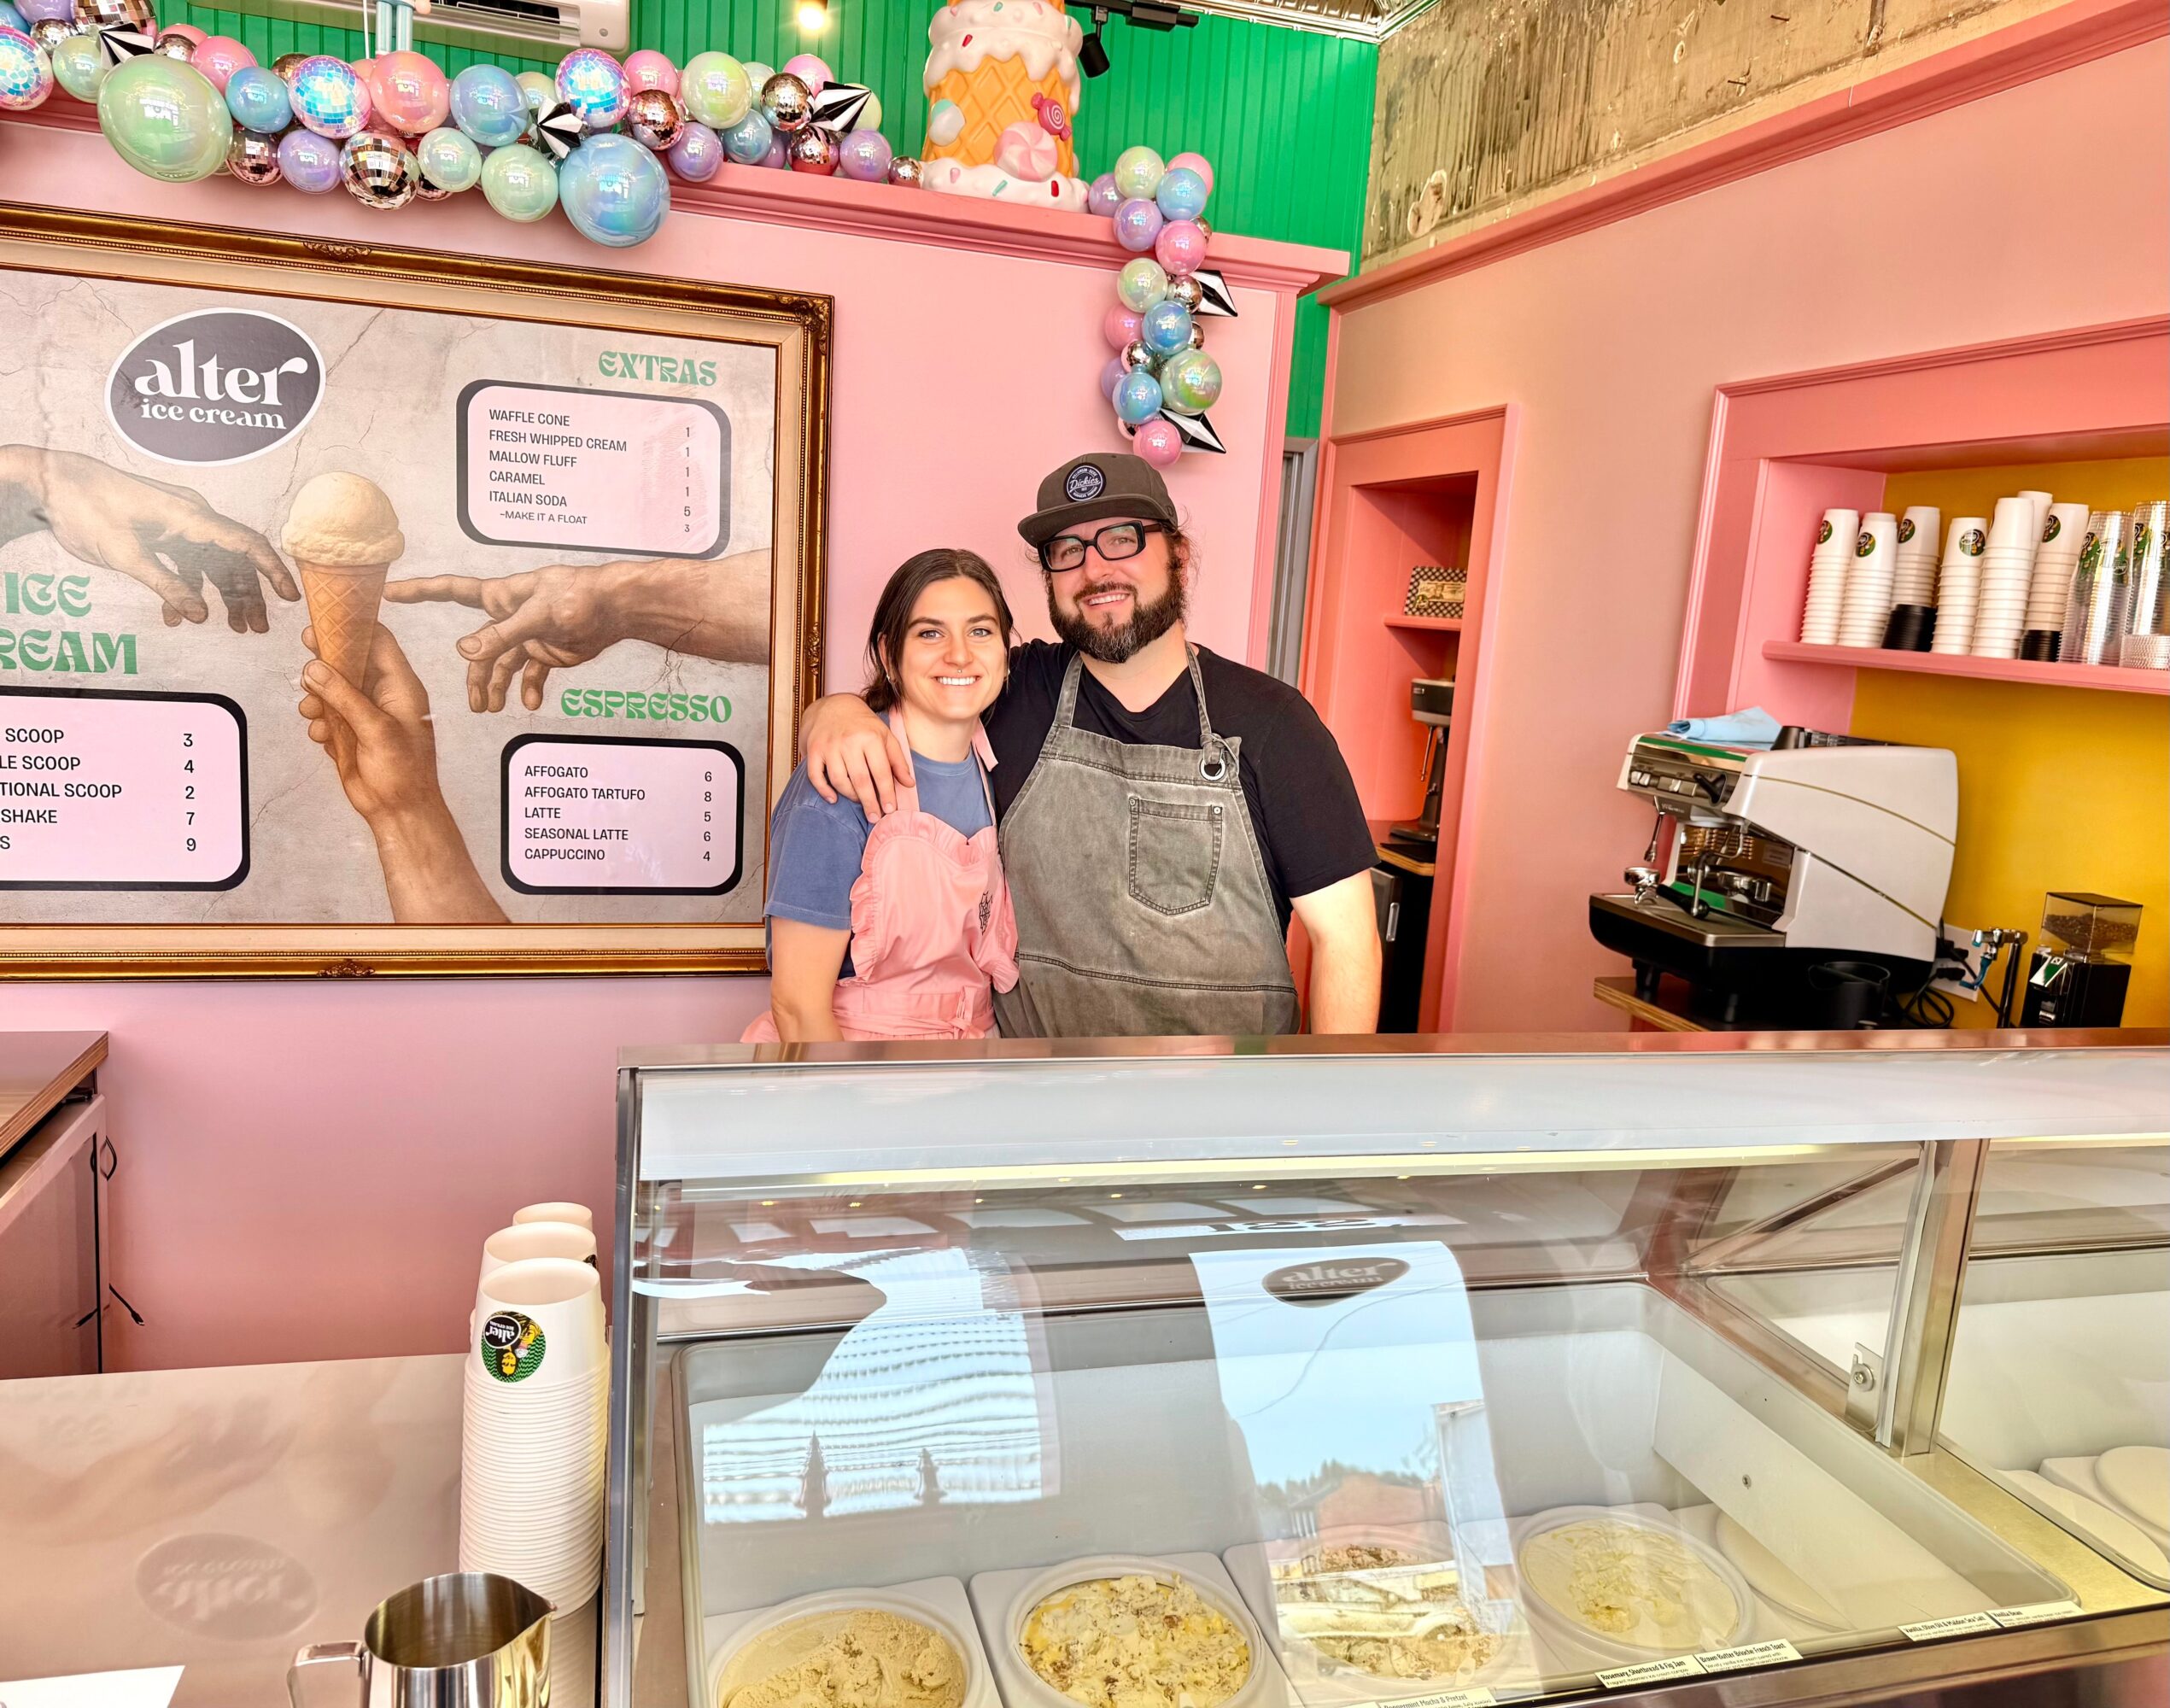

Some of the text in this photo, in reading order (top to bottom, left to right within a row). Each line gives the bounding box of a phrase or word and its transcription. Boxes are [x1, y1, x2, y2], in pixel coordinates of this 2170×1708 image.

[134, 339, 308, 407] alter
[598, 350, 717, 386] EXTRAS
[141, 397, 287, 430] ice cream
[489, 409, 570, 427] WAFFLE CONE
[686, 427, 691, 437] 1
[489, 430, 627, 452] FRESH WHIPPED CREAM
[489, 450, 577, 468] MALLOW FLUFF
[686, 447, 690, 458] 1
[489, 471, 546, 485] CARAMEL
[686, 467, 690, 477] 1
[686, 486, 690, 497] 1
[1069, 477, 1101, 493] Dickies
[489, 491, 568, 507] ITALIAN SODA
[537, 512, 546, 522] IT
[558, 514, 588, 524] FLOAT
[684, 506, 691, 517] 5
[685, 524, 690, 533] 3
[5, 572, 92, 617] ICE
[561, 688, 732, 723] ESPRESSO
[5, 728, 65, 744] SCOOP
[183, 733, 194, 747] 3
[22, 756, 81, 771] SCOOP
[184, 759, 195, 774] 4
[524, 765, 588, 778] AFFOGATO
[705, 771, 712, 782] 6
[64, 783, 122, 798] SCOOP
[184, 785, 196, 800] 2
[524, 786, 646, 800] AFFOGATO TARTUFO
[704, 791, 712, 803] 8
[185, 811, 196, 826] 7
[524, 807, 561, 819] LATTE
[704, 811, 711, 822] 5
[524, 828, 629, 841] SEASONAL LATTE
[703, 831, 711, 842] 6
[186, 837, 196, 852] 9
[524, 848, 605, 861] CAPPUCCINO
[703, 851, 711, 862] 4
[1282, 1262, 1398, 1284] alter
[485, 1325, 515, 1342] alter
[1419, 1698, 1439, 1706] Mocha
[1445, 1693, 1467, 1702] Pretzel
